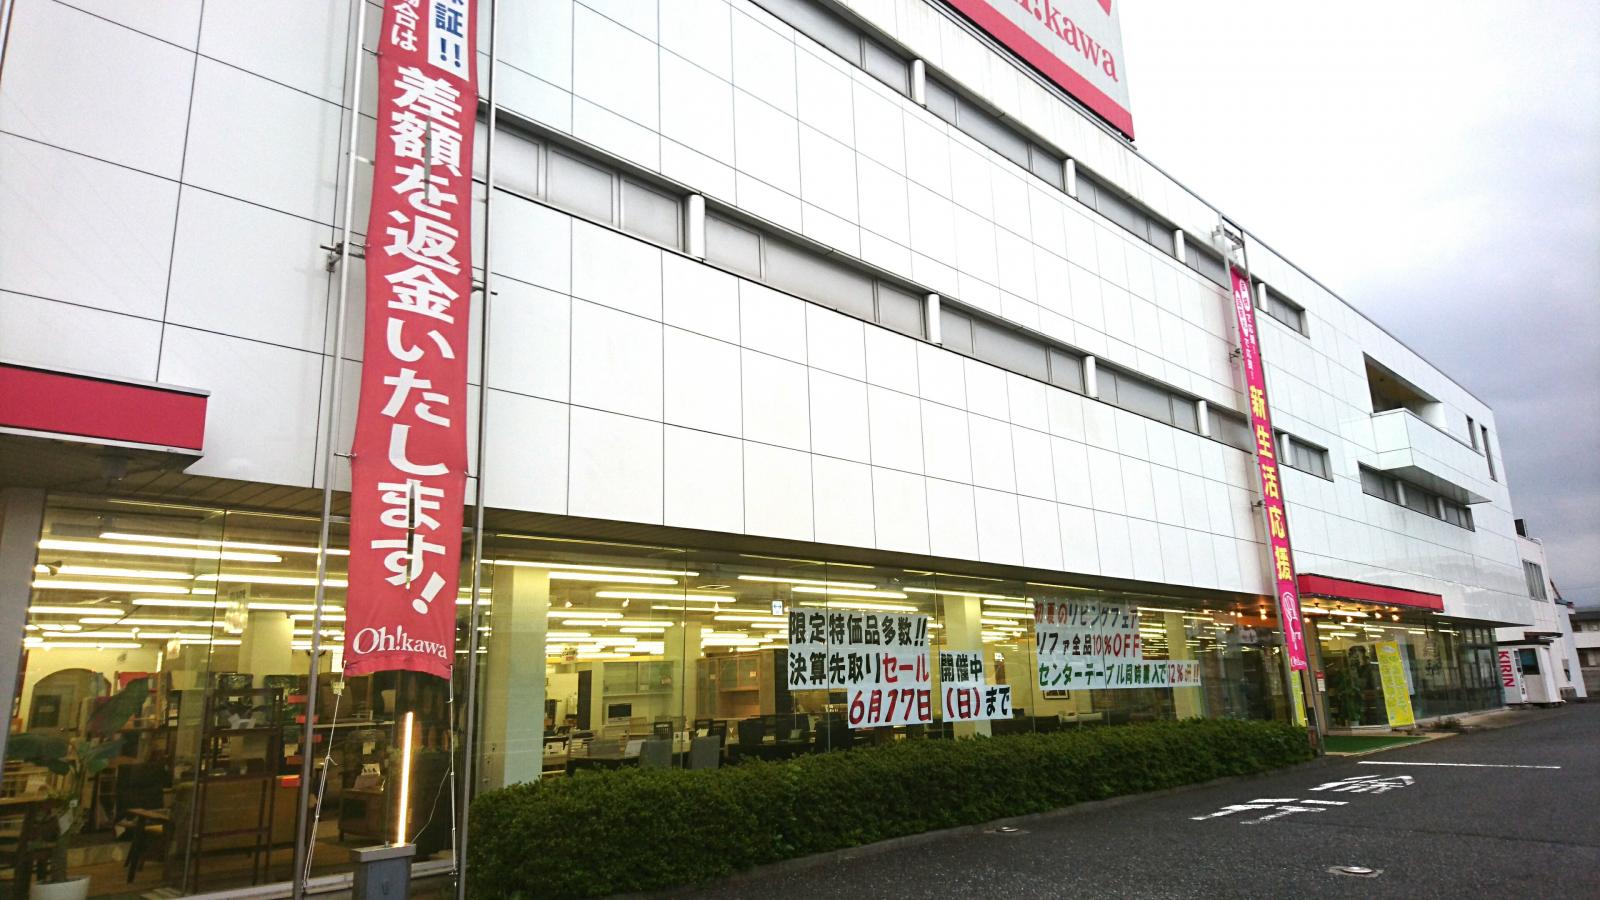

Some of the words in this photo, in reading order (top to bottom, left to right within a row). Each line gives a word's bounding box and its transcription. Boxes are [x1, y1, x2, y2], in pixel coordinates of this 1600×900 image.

[1250, 385, 1293, 581] 新生活応援
[352, 625, 448, 660] Oh!kawa
[788, 611, 927, 647] 限定特価品多数!!
[789, 652, 930, 686] 決算先取りセール
[941, 653, 983, 683] 開催中
[1498, 650, 1515, 688] KIRIN
[849, 688, 932, 725] 6月17日
